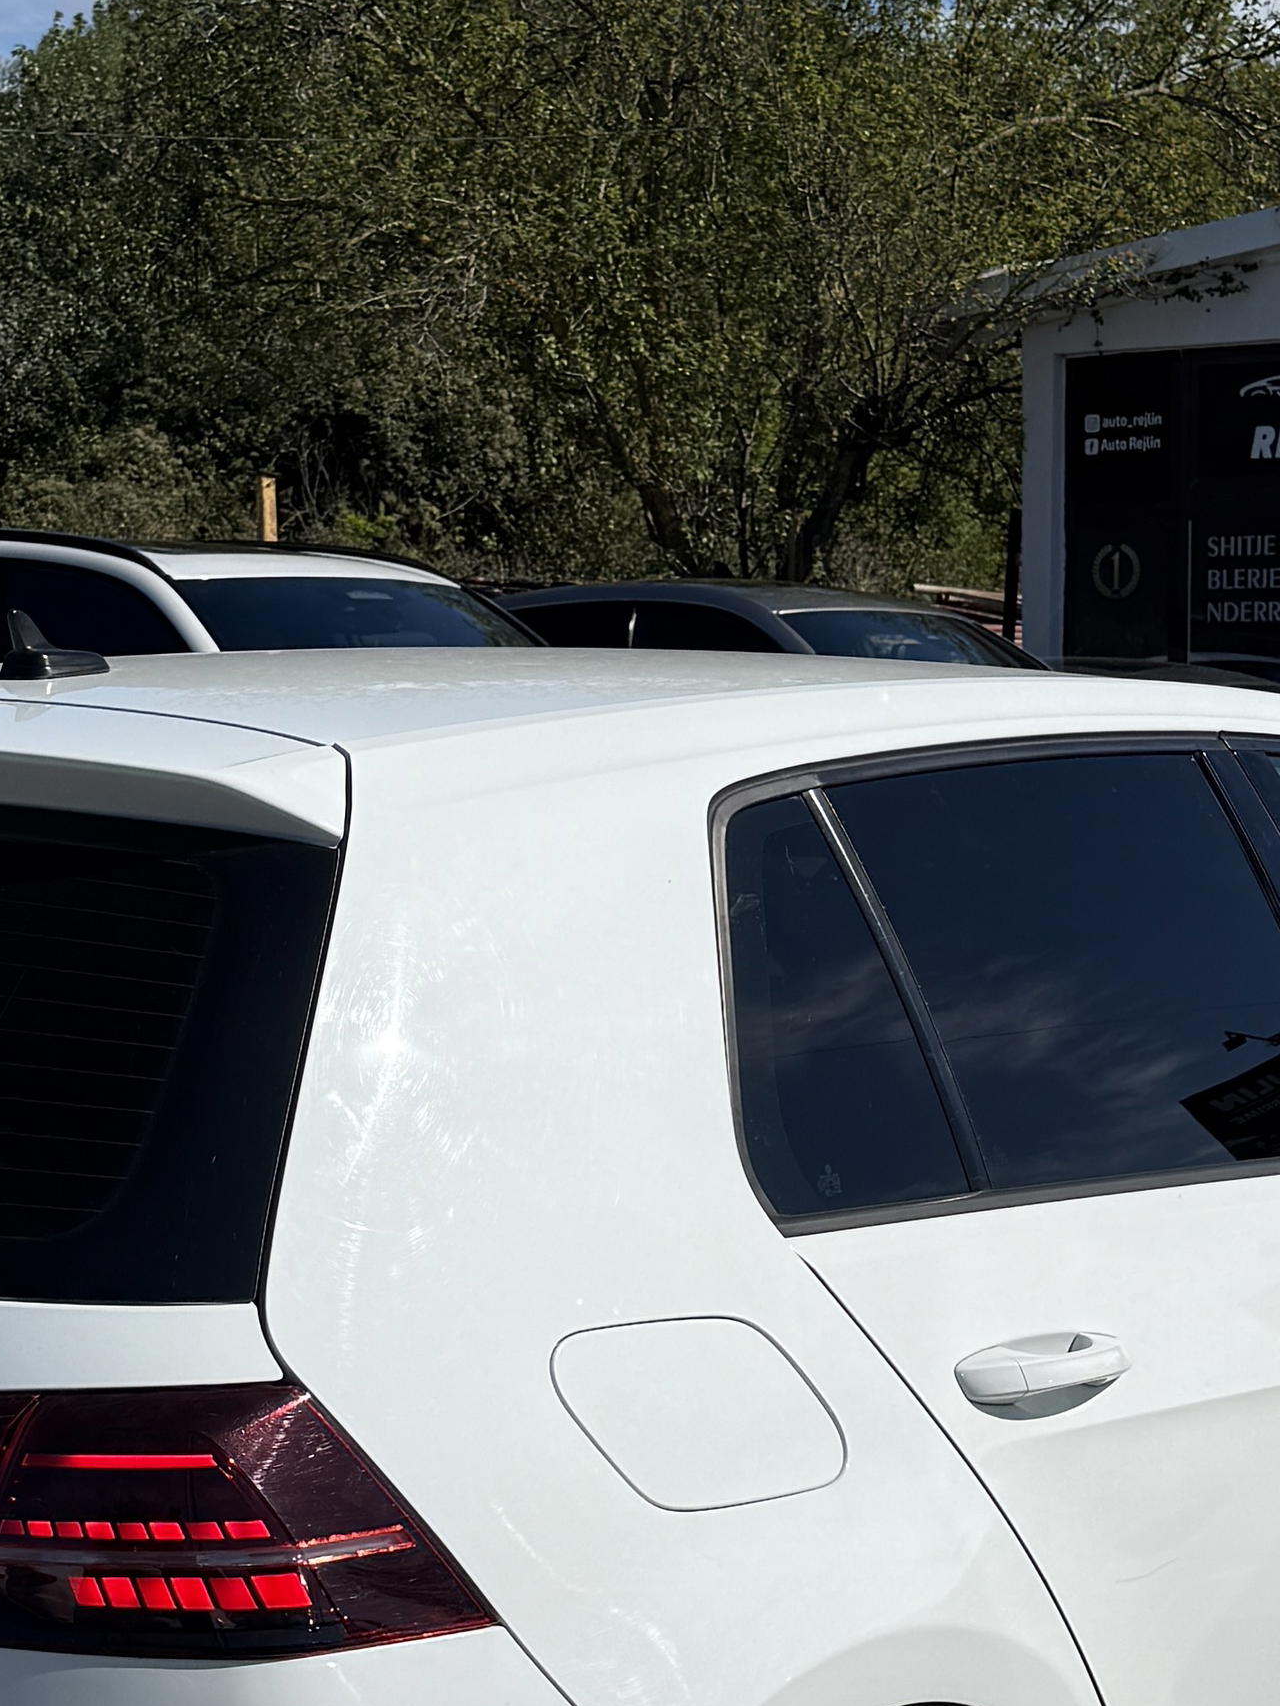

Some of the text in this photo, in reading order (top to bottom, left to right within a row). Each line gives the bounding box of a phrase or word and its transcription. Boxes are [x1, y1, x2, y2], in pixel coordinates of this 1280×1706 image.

[1101, 411, 1163, 428] auto_rejlin
[1100, 435, 1161, 452] Auto Rejlin
[1207, 534, 1277, 557] SHITJE
